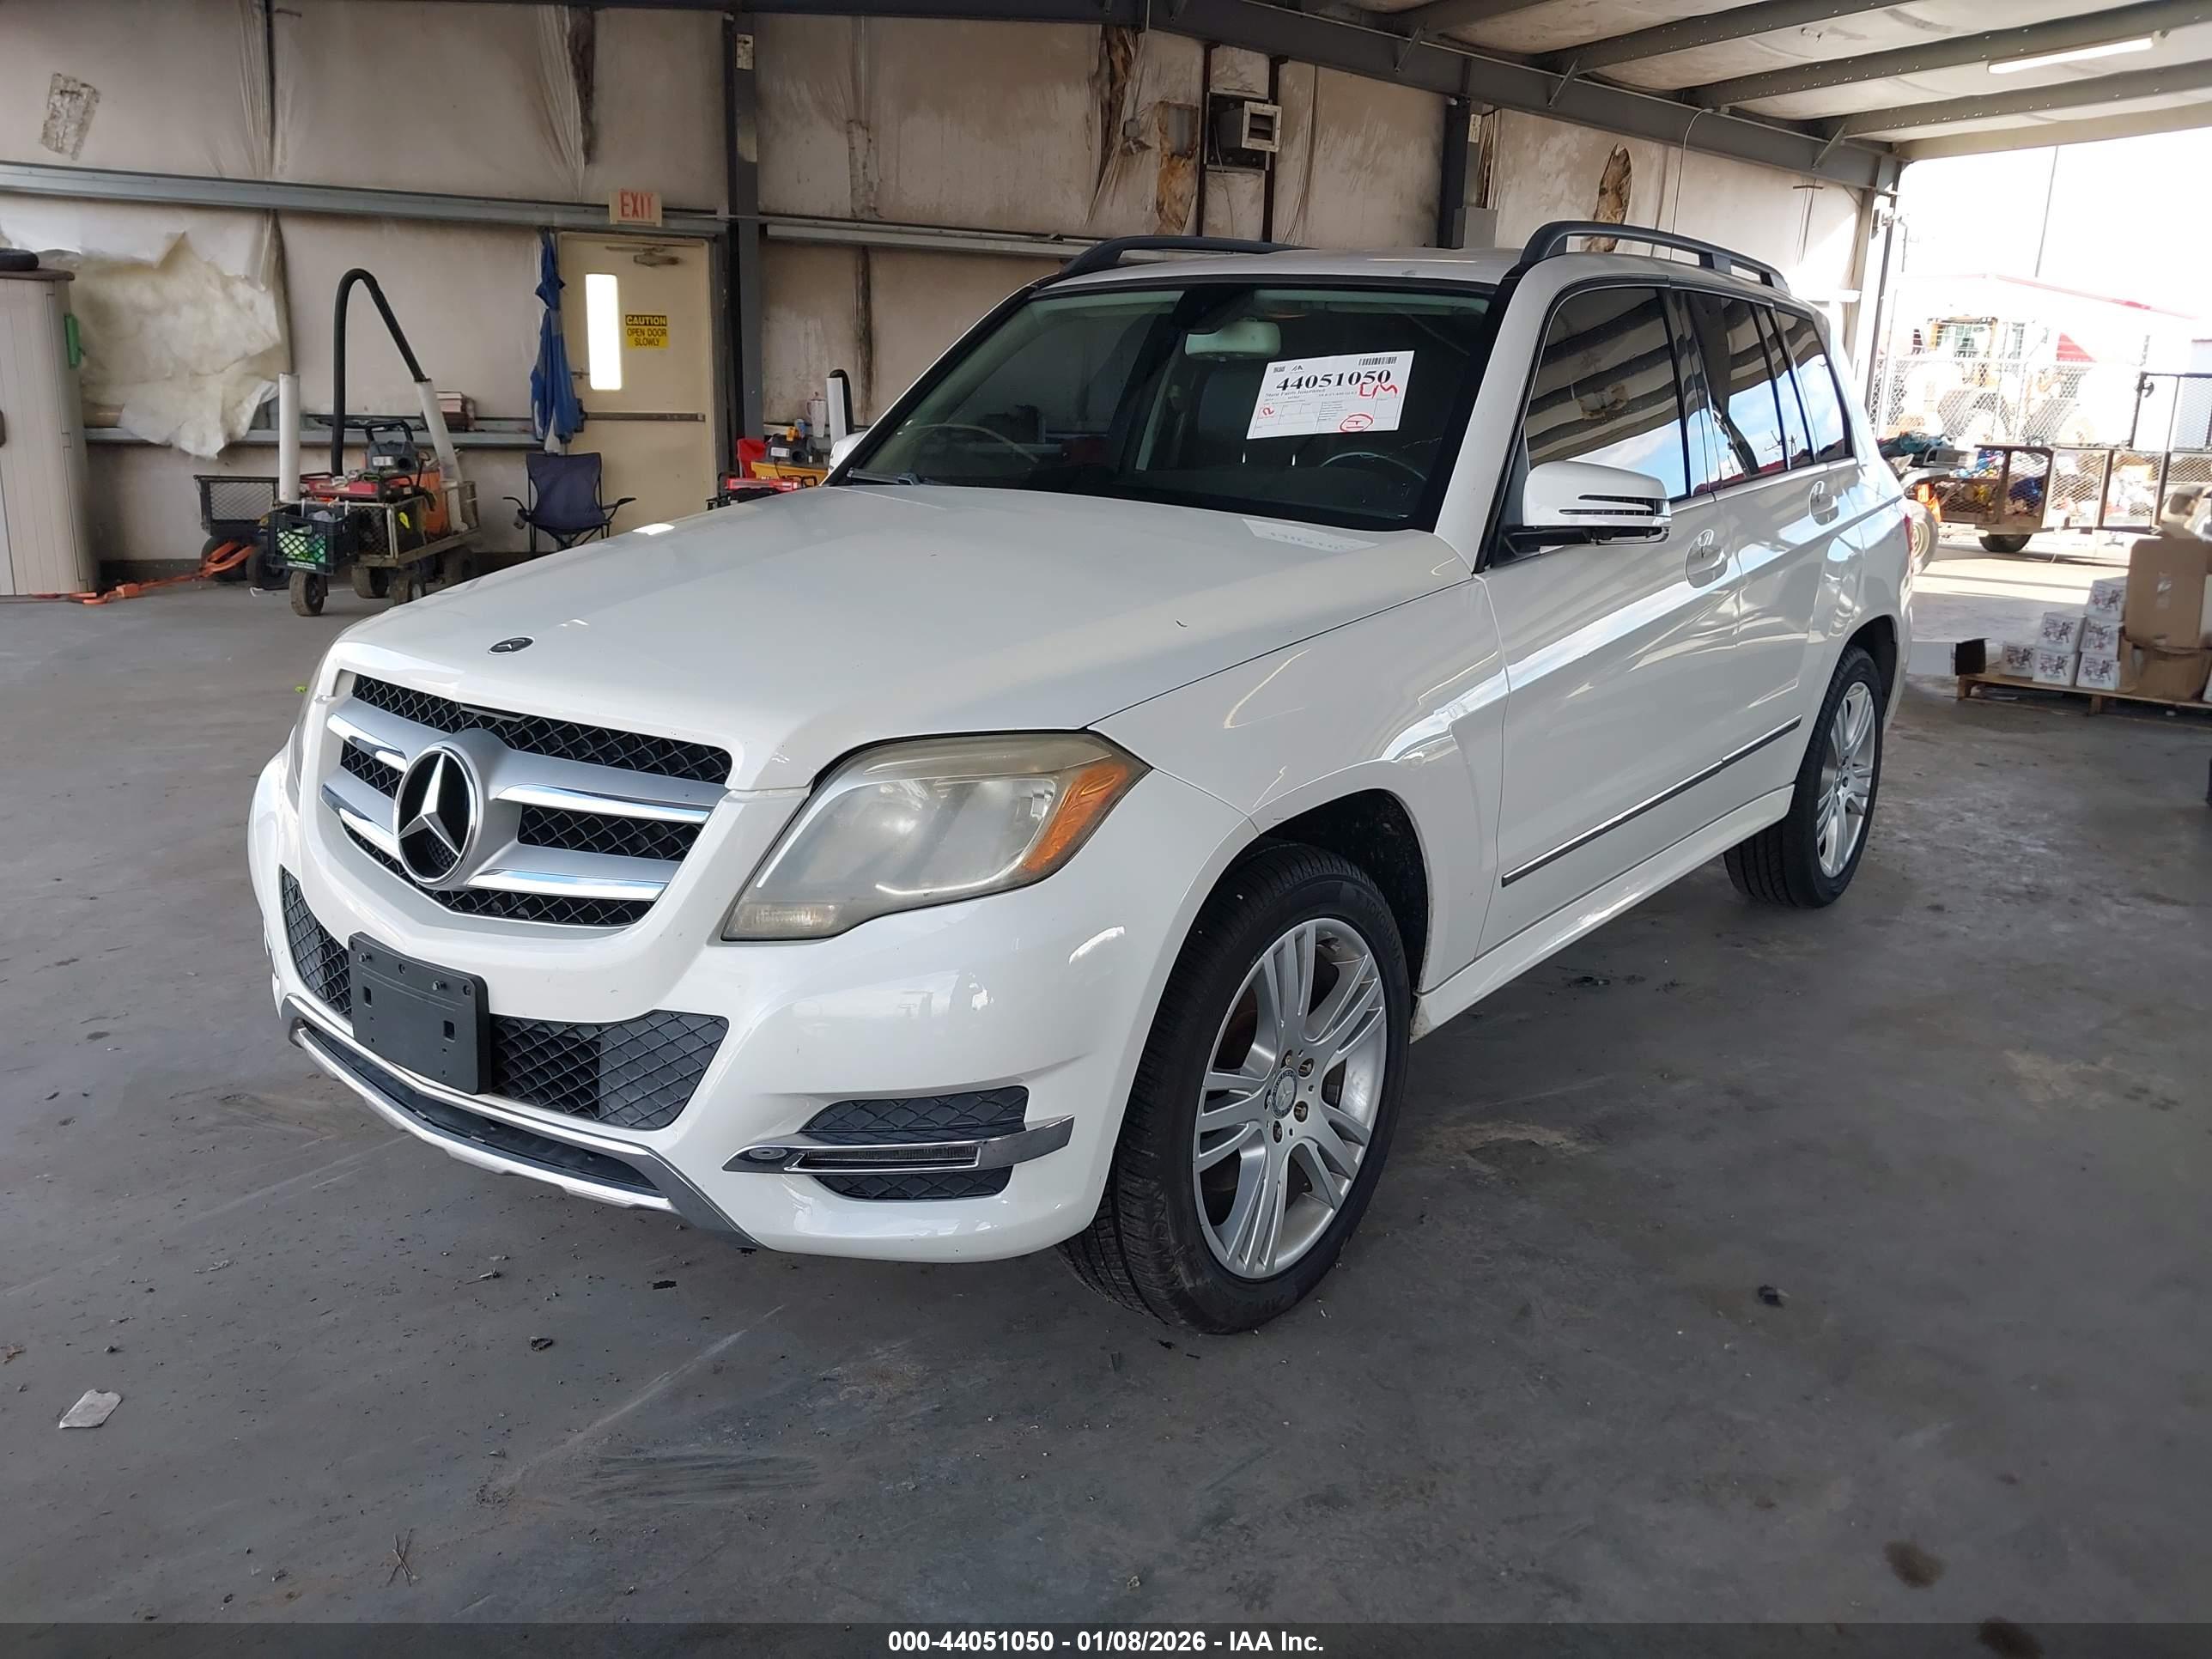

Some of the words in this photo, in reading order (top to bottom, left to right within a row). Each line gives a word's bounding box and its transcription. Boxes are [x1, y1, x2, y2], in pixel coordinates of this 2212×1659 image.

[621, 191, 653, 219] EXIT
[627, 316, 666, 325] CAUTION
[627, 328, 646, 337] OPEN
[647, 328, 667, 337] DOOR
[635, 337, 659, 347] SLOWLY
[1276, 369, 1391, 392] 44051050
